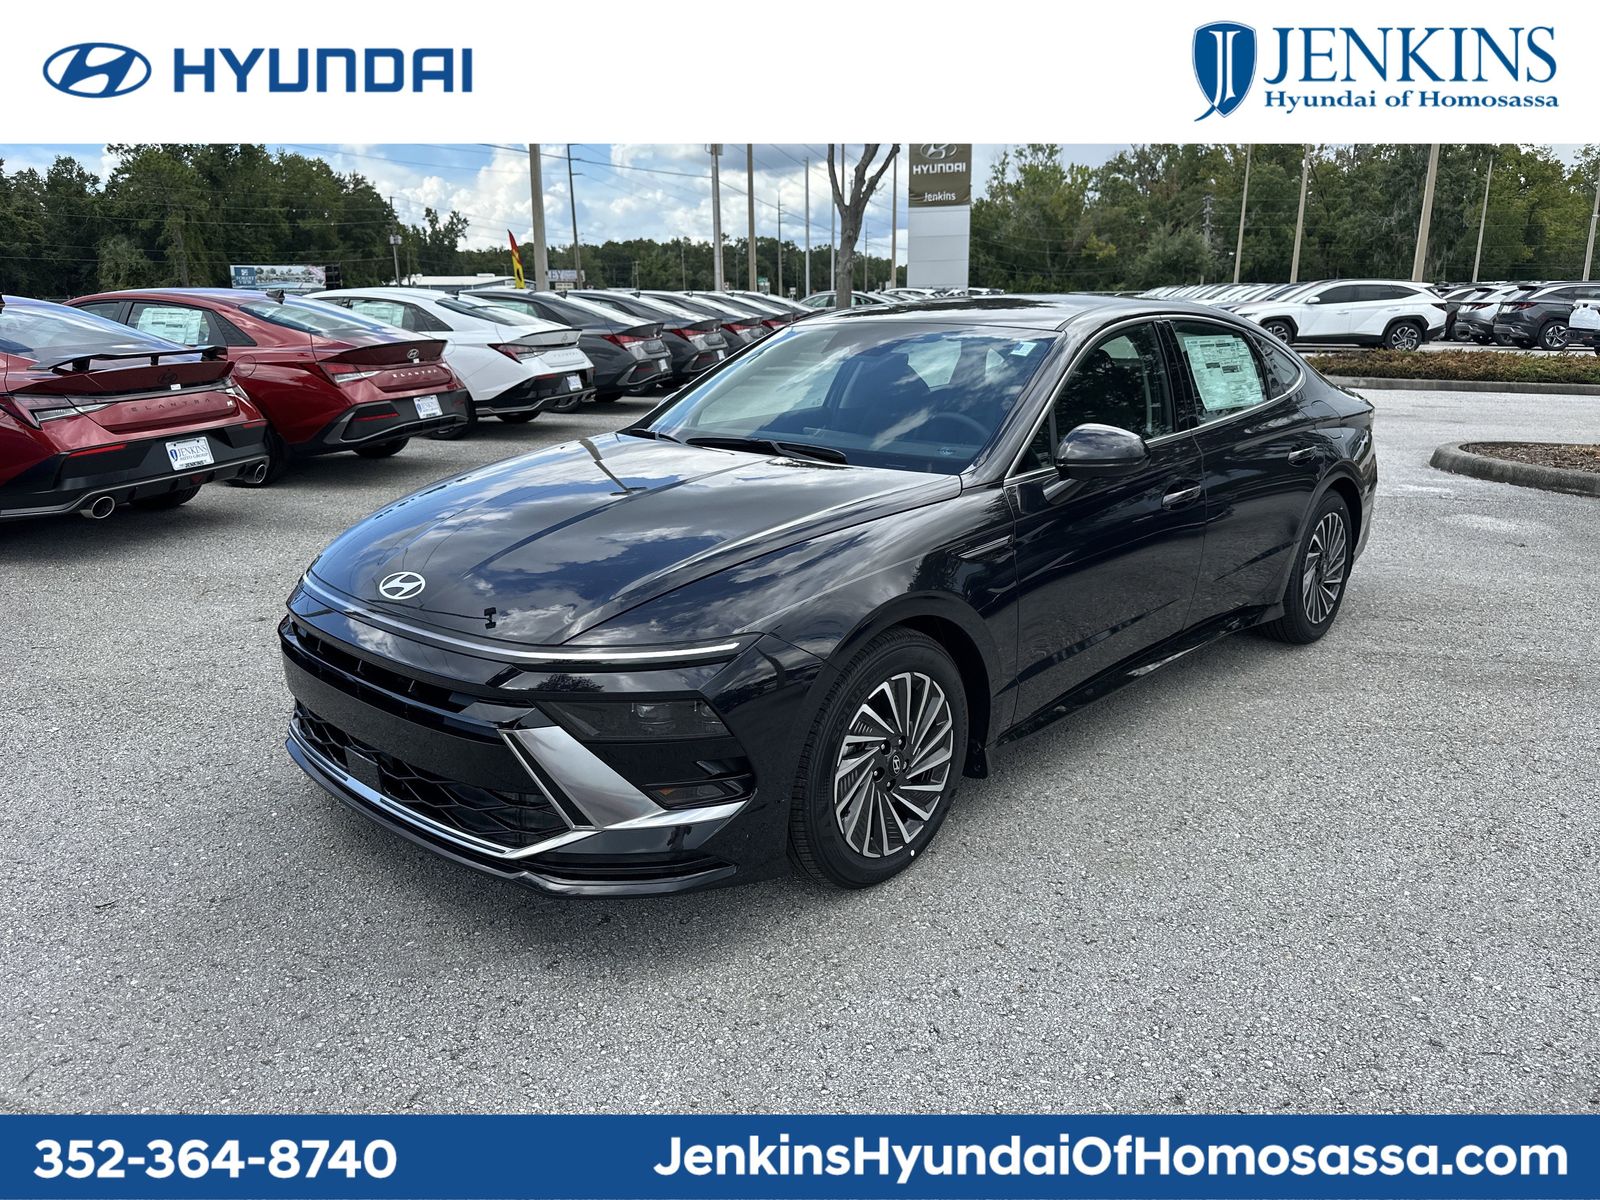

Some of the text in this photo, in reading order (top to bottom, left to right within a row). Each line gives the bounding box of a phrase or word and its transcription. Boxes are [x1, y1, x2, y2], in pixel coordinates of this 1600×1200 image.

[912, 162, 966, 175] HYUNDAI
[924, 191, 956, 202] Jenkins
[131, 399, 210, 412] ELANTRA
[177, 445, 207, 457] JENKINS
